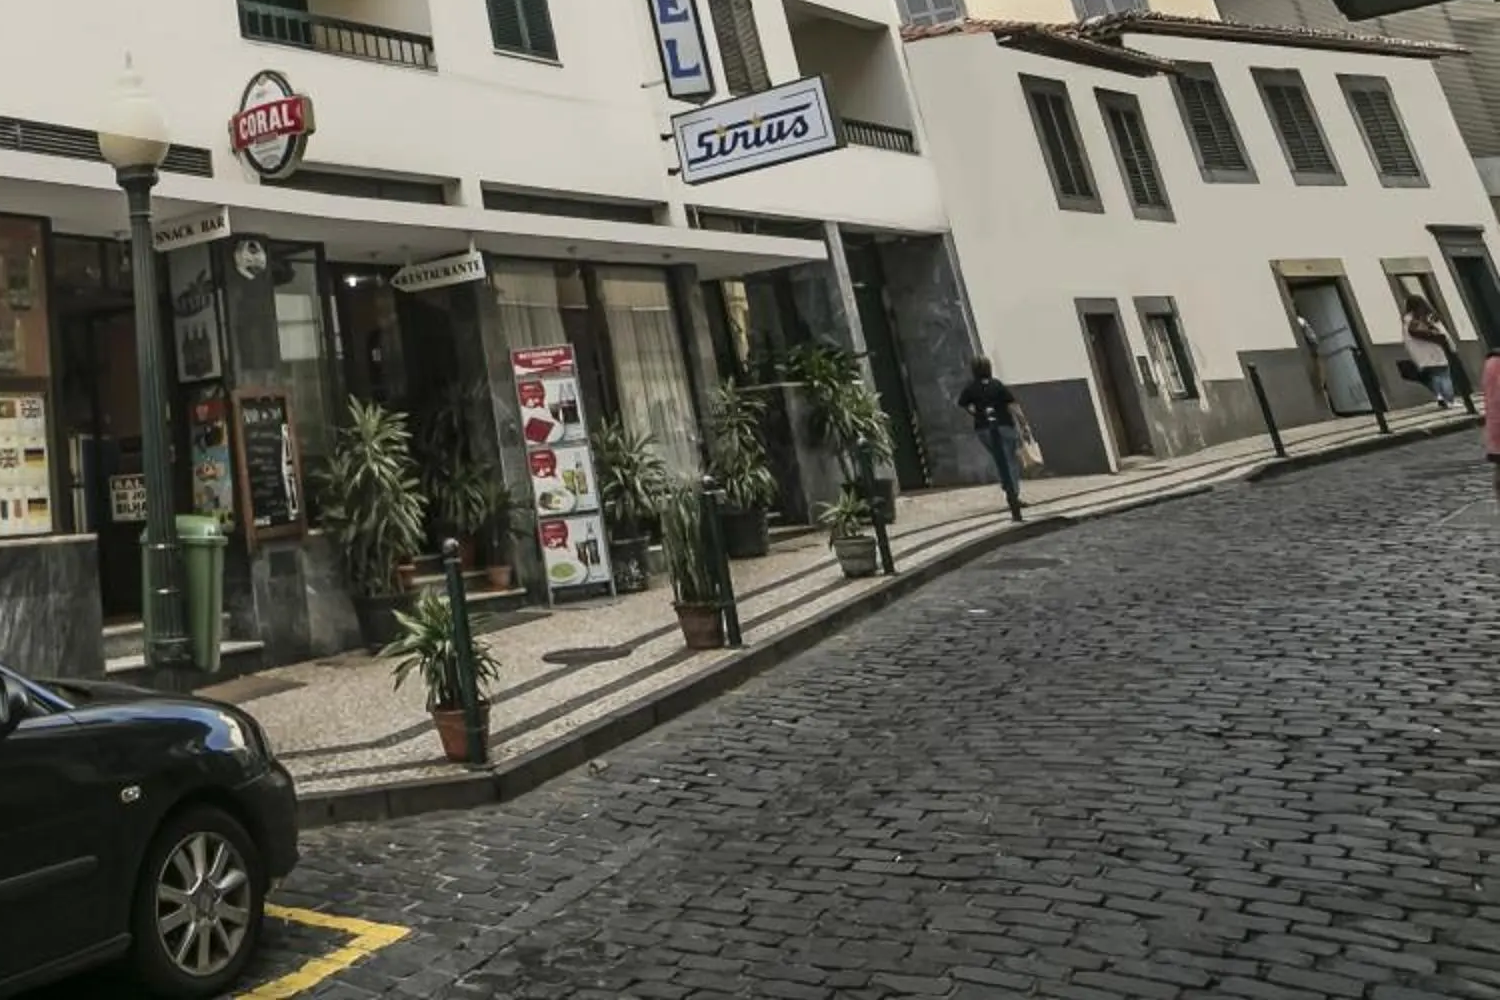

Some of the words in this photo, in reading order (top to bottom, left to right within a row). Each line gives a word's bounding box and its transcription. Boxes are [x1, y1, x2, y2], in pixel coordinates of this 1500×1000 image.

[239, 103, 295, 140] CORAL
[155, 224, 195, 244] SNACK
[201, 215, 225, 233] BAR
[401, 259, 480, 285] RESTAURANTE
